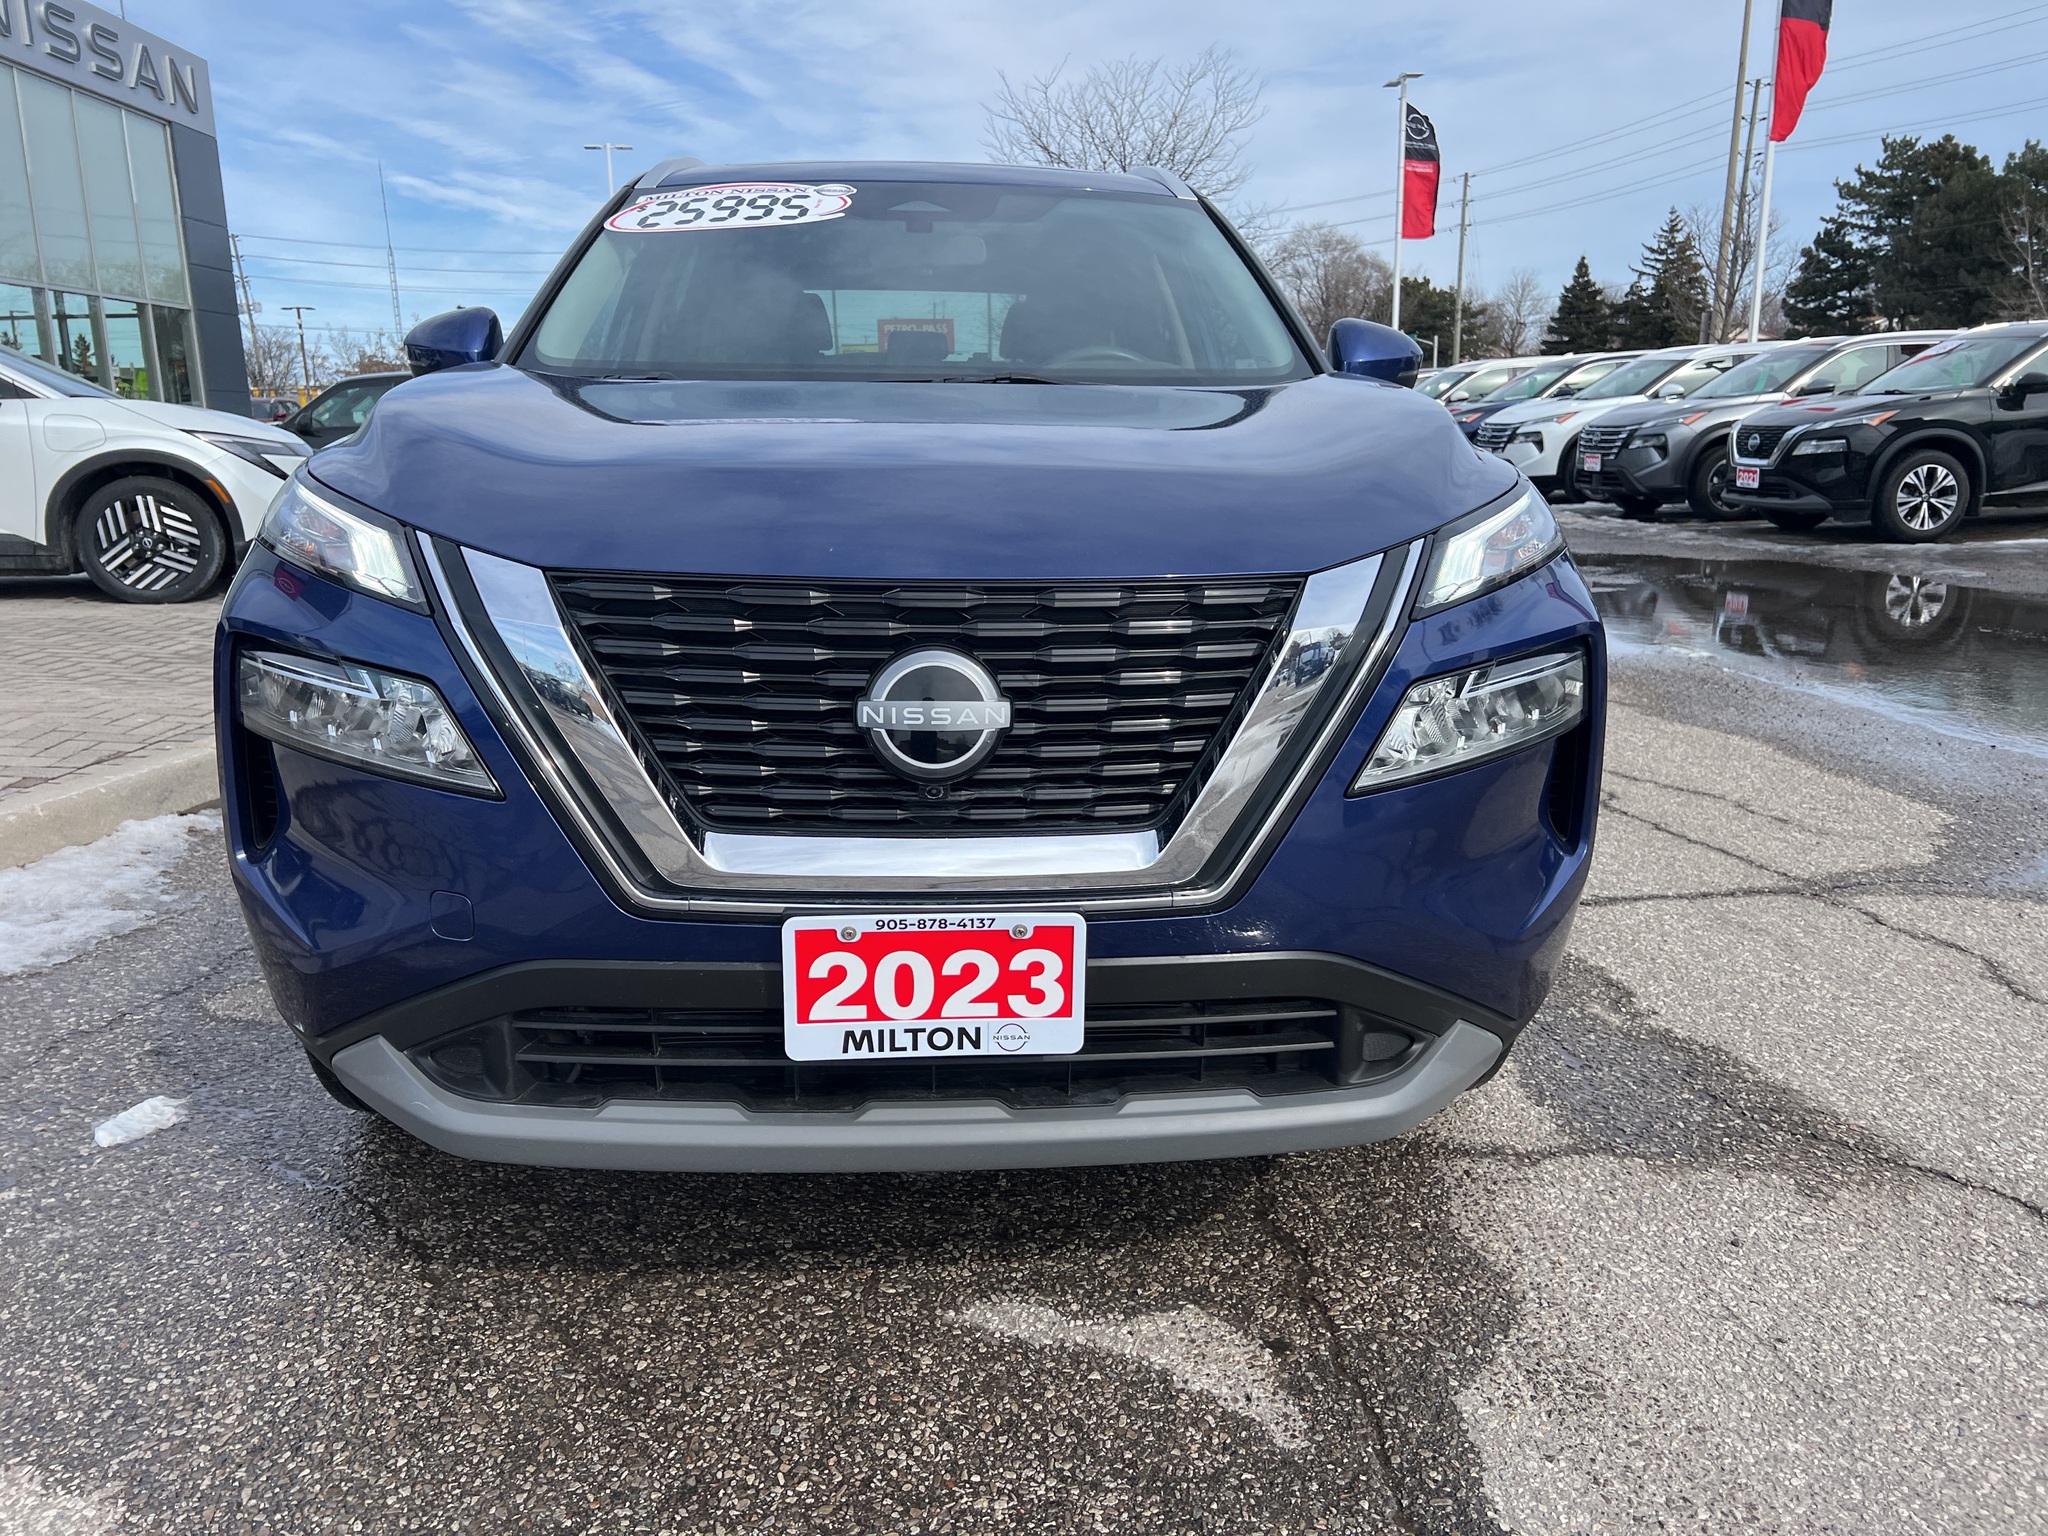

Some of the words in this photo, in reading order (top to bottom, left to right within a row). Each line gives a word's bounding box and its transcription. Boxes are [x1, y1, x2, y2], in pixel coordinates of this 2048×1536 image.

[646, 190, 723, 201] MILTON
[1738, 472, 1757, 483] 2021
[862, 705, 1006, 725] NISSAN
[875, 918, 996, 930] 905-878-4137
[808, 948, 1065, 1021] 2023
[842, 1026, 982, 1054] MILTON
